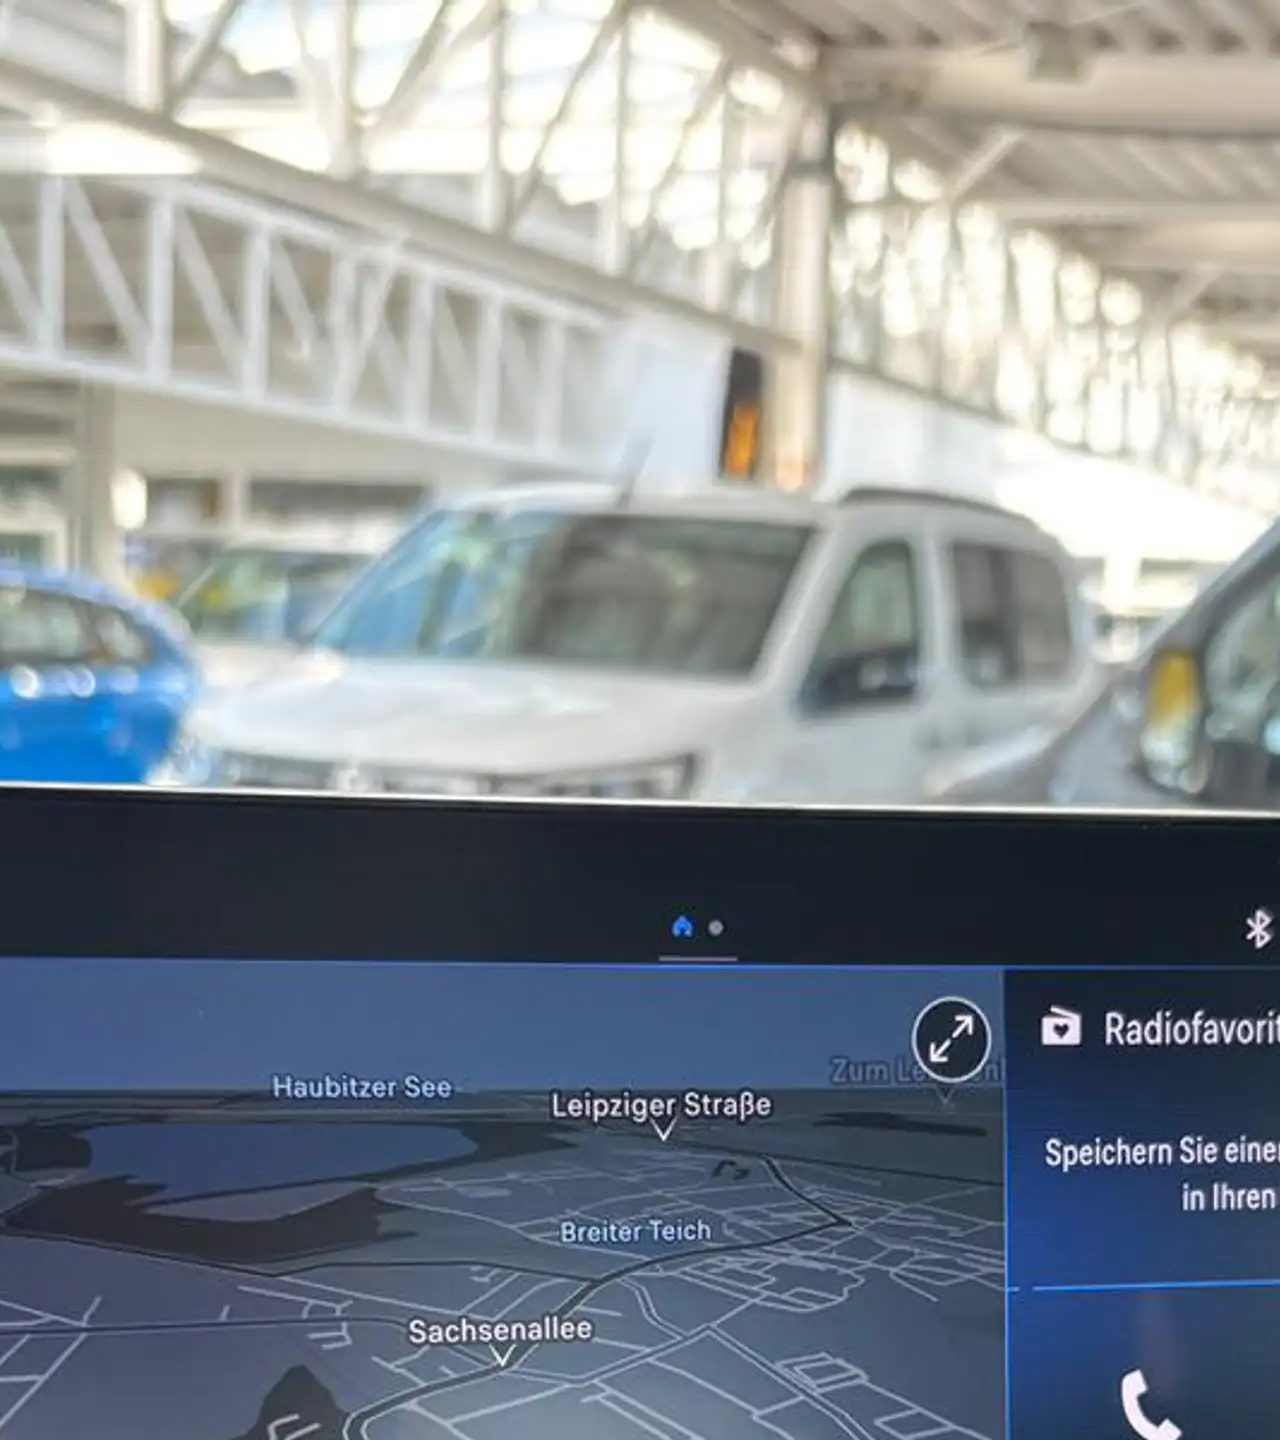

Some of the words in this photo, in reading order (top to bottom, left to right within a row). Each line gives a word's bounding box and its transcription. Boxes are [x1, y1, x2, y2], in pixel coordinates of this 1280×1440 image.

[272, 1074, 398, 1099] Haubitzer
[404, 1074, 452, 1099] See
[551, 1092, 676, 1123] Leipziger
[684, 1091, 772, 1121] Straße
[1045, 1136, 1173, 1170] Speichern
[1180, 1136, 1219, 1163] Sie
[1183, 1184, 1205, 1210] in
[1213, 1183, 1275, 1210] Ihren
[561, 1219, 643, 1244] Breiter
[649, 1217, 712, 1242] Teich
[408, 1316, 593, 1345] Sachsenallee
